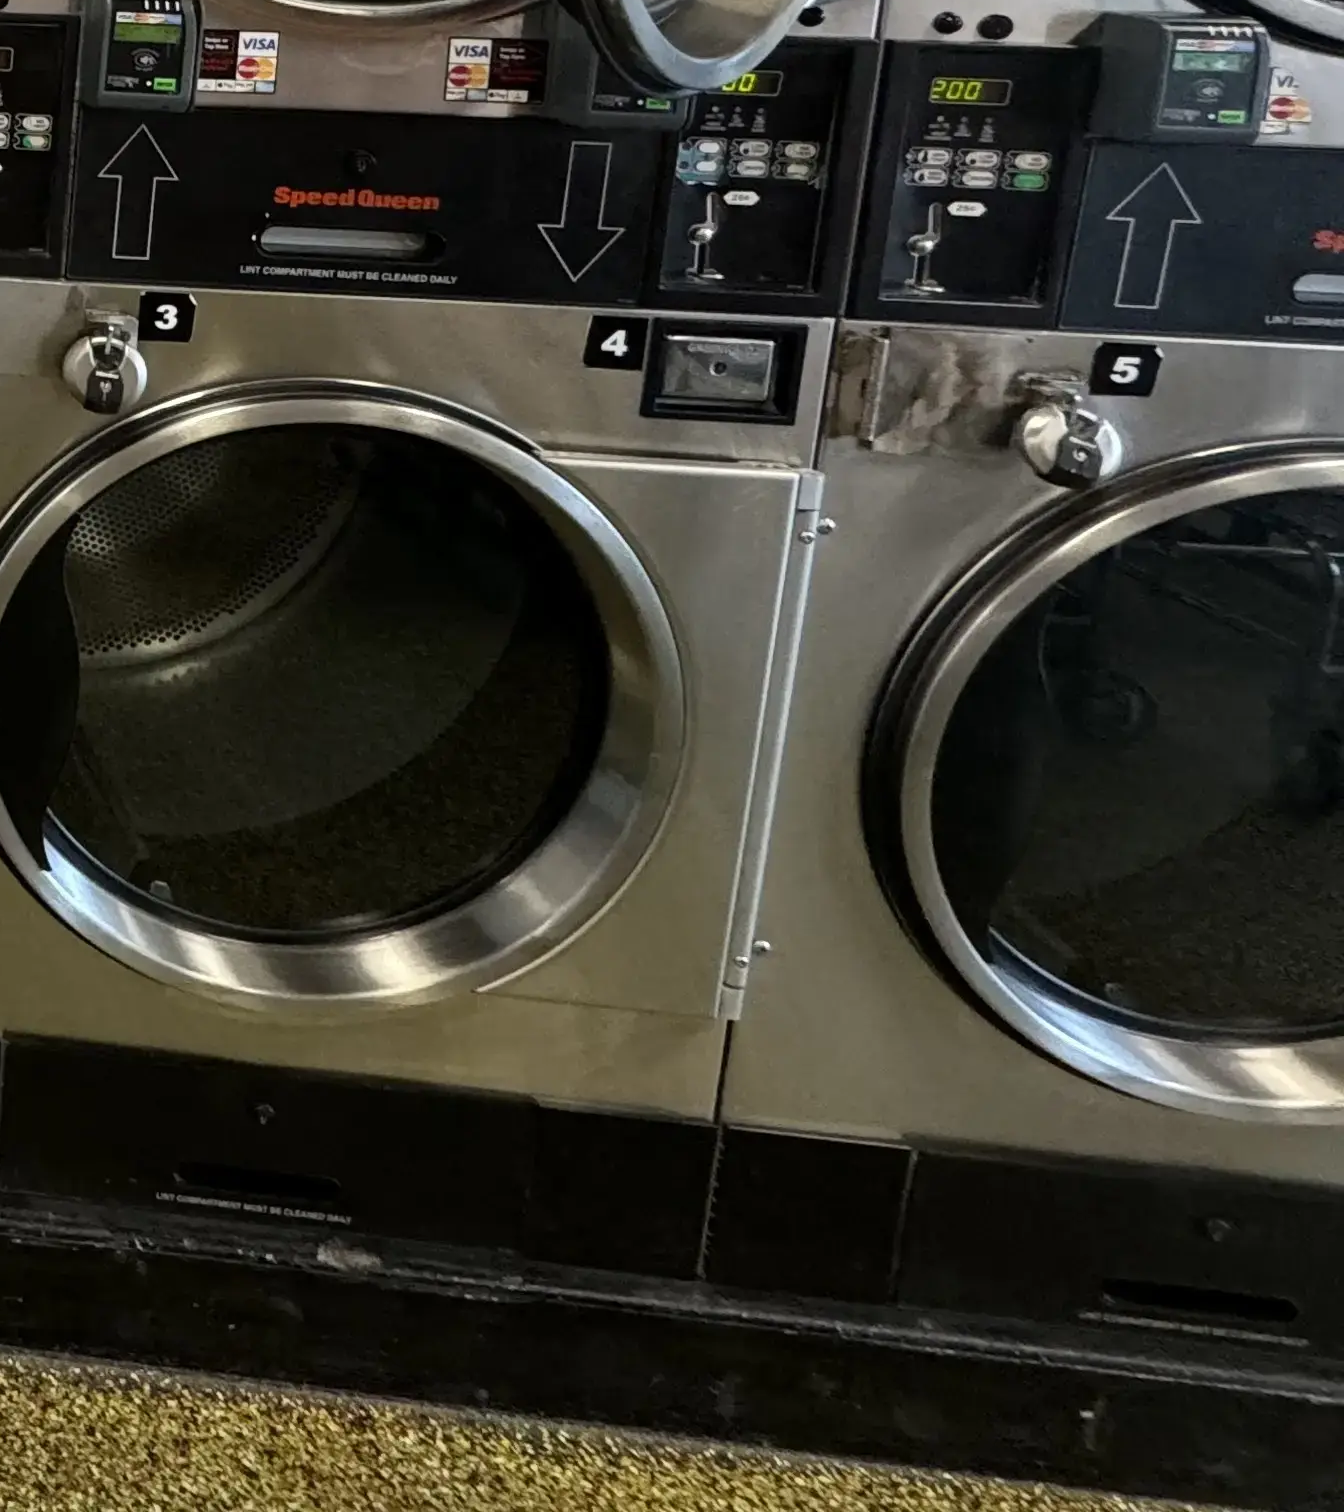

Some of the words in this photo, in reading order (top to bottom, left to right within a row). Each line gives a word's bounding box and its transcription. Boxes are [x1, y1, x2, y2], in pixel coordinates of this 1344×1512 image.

[243, 38, 276, 51] VISA
[454, 44, 489, 58] VISA
[930, 80, 981, 100] 200
[273, 186, 356, 208] Speed
[357, 189, 440, 211] Queen
[240, 265, 261, 275] LINT
[262, 266, 336, 279] COMPARTMENT
[337, 270, 365, 280] MUST
[366, 271, 379, 281] BE
[381, 272, 428, 284] CLEANED
[429, 275, 459, 285] DAILY
[154, 304, 178, 330] 3
[600, 329, 628, 357] 4
[1109, 356, 1141, 384] 5
